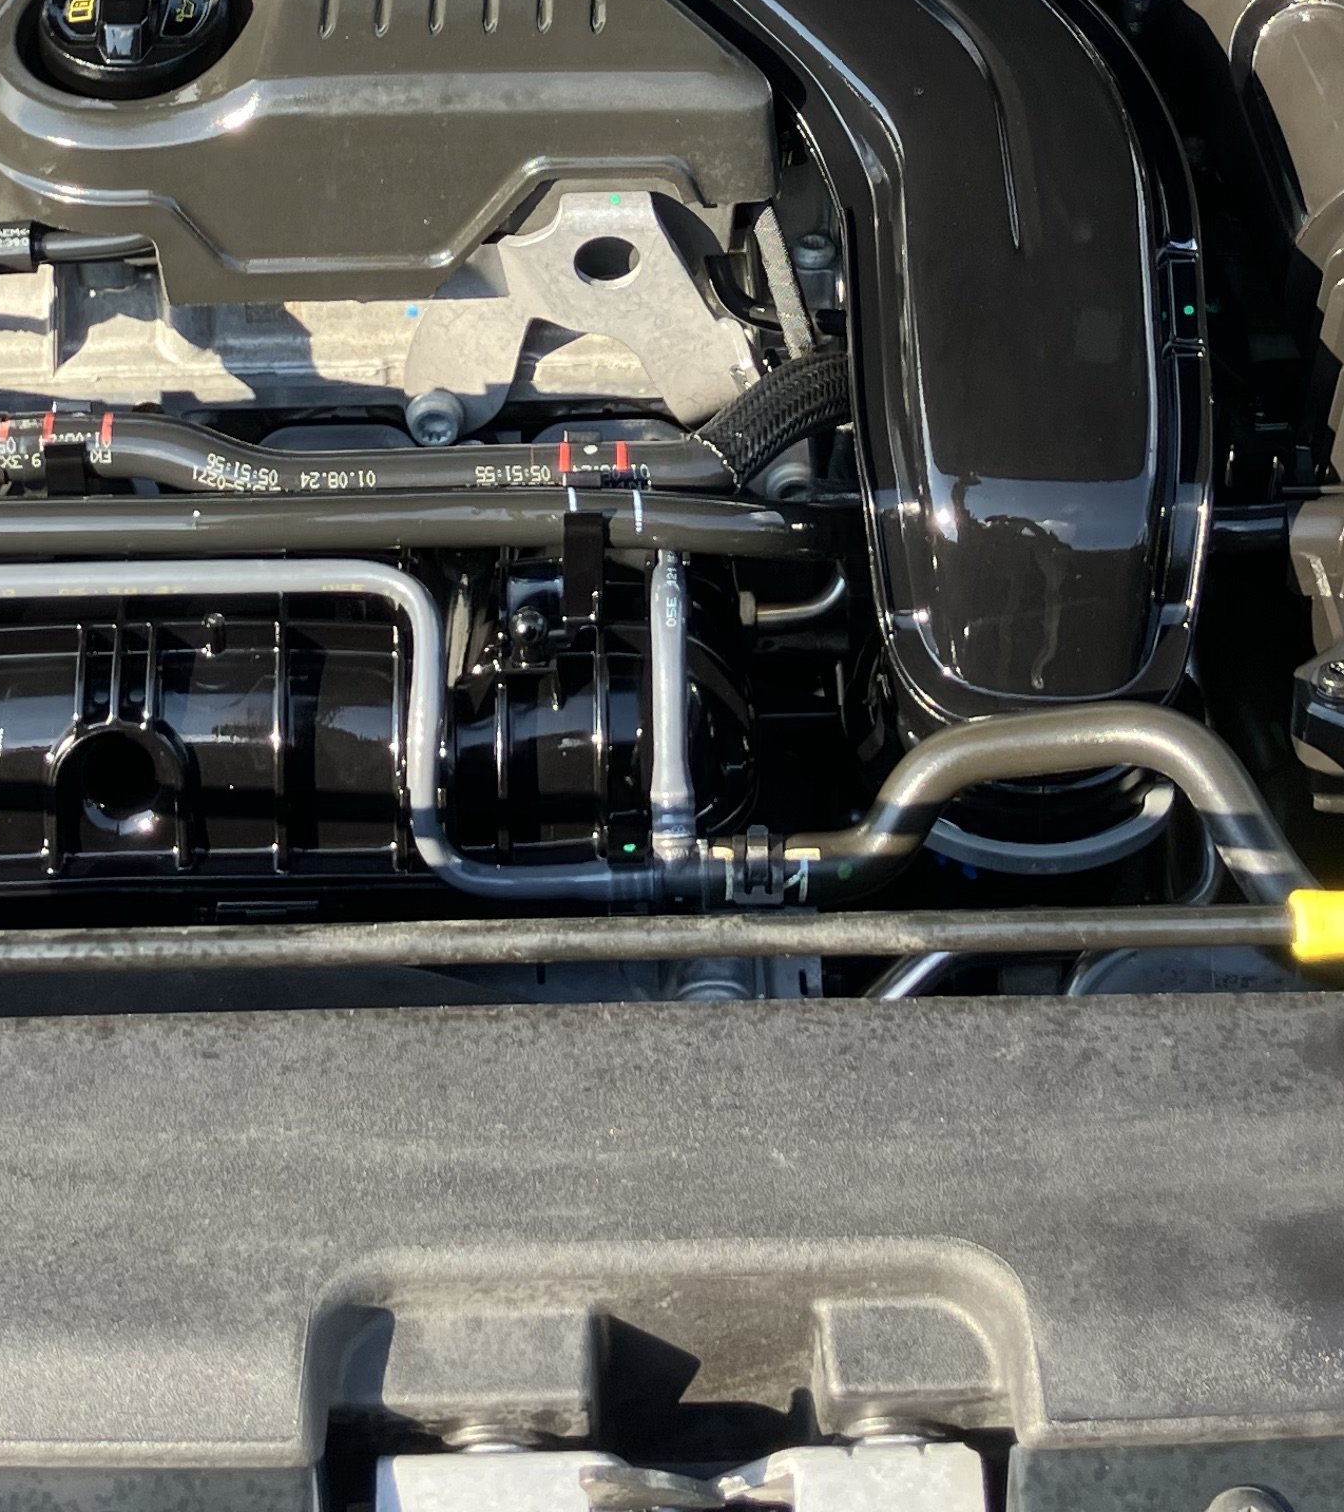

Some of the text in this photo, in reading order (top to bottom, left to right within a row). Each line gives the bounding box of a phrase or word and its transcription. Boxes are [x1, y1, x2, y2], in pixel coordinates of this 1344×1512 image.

[206, 452, 377, 489] 01.08.24 05:51:56
[475, 464, 552, 483] 05:51:55
[665, 597, 677, 628] 05E
